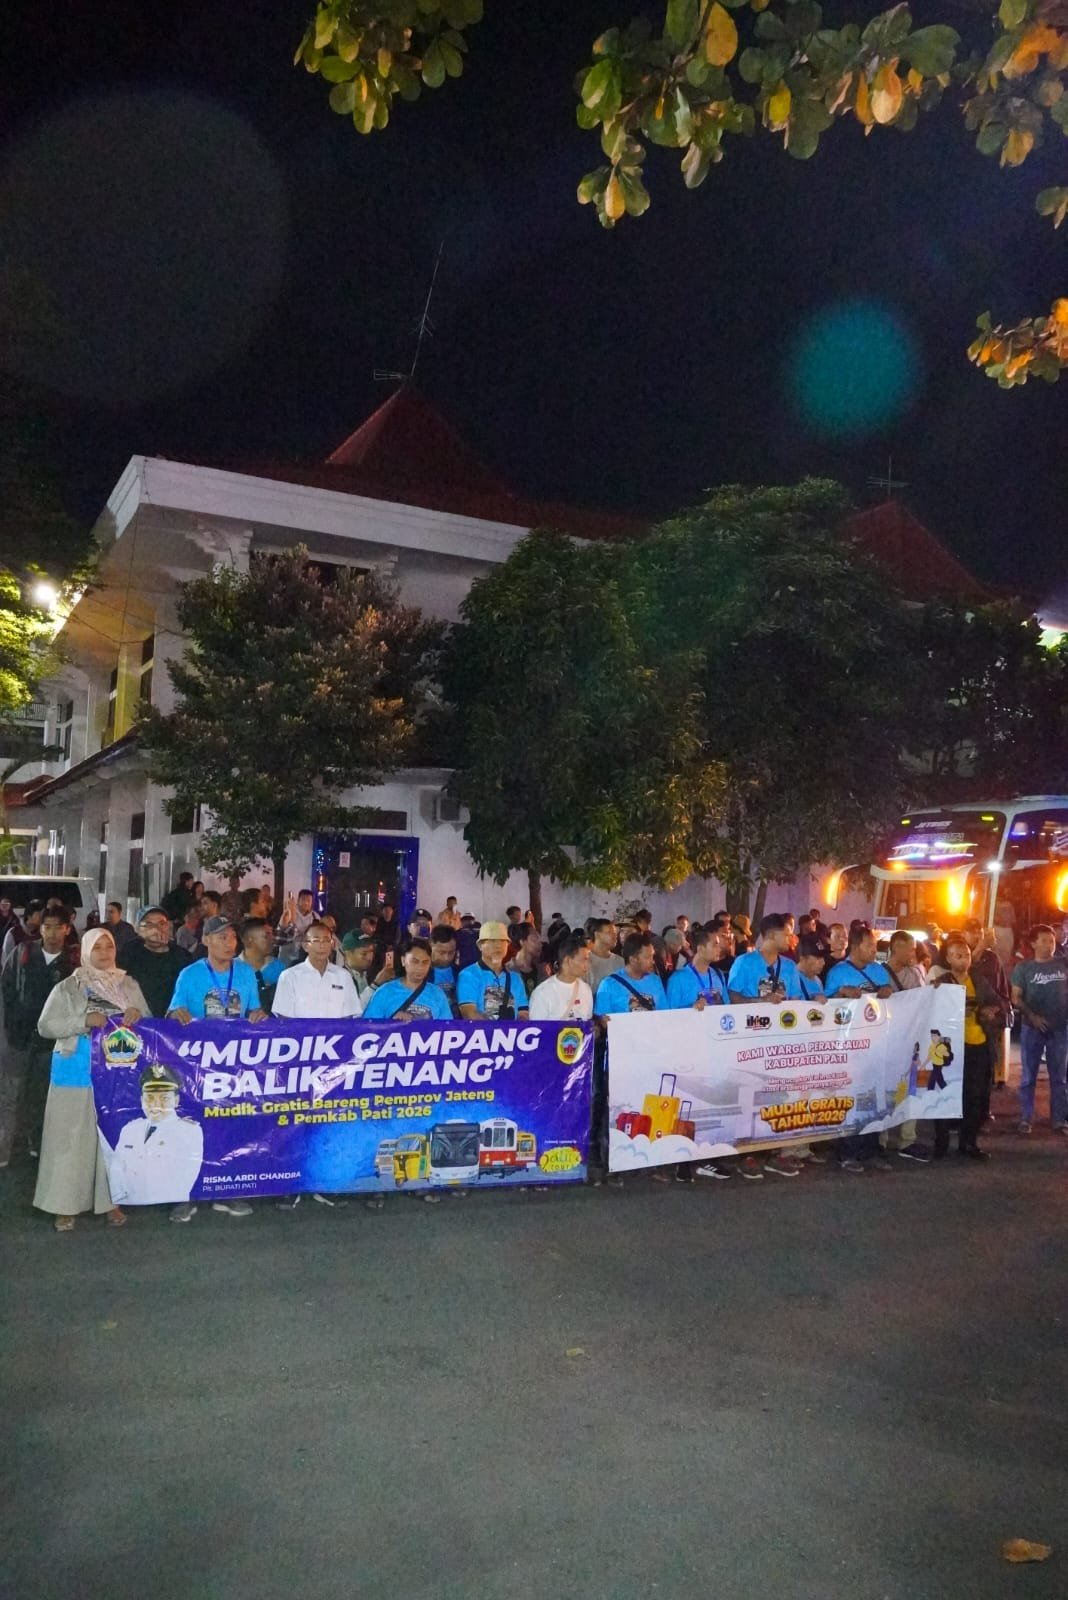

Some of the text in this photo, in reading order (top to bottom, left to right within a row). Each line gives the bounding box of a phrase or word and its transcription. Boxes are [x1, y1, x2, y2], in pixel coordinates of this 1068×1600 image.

[351, 1027, 542, 1059] GAMPANG
[737, 1048, 765, 1062] KAMI
[766, 1044, 807, 1056] WARGA
[764, 1053, 848, 1070] KABUPATEN PATI
[201, 1065, 330, 1101] BALIK
[203, 1088, 496, 1118] Mudik Gratis Bareng Pemprov Jateng
[761, 1097, 855, 1120] MUDIK GRATIS
[277, 1105, 433, 1126] & Pemkab Pati 2026
[768, 1110, 847, 1132] TAHUN 2026
[202, 1171, 302, 1184] RISMA ARDI CHANDRA
